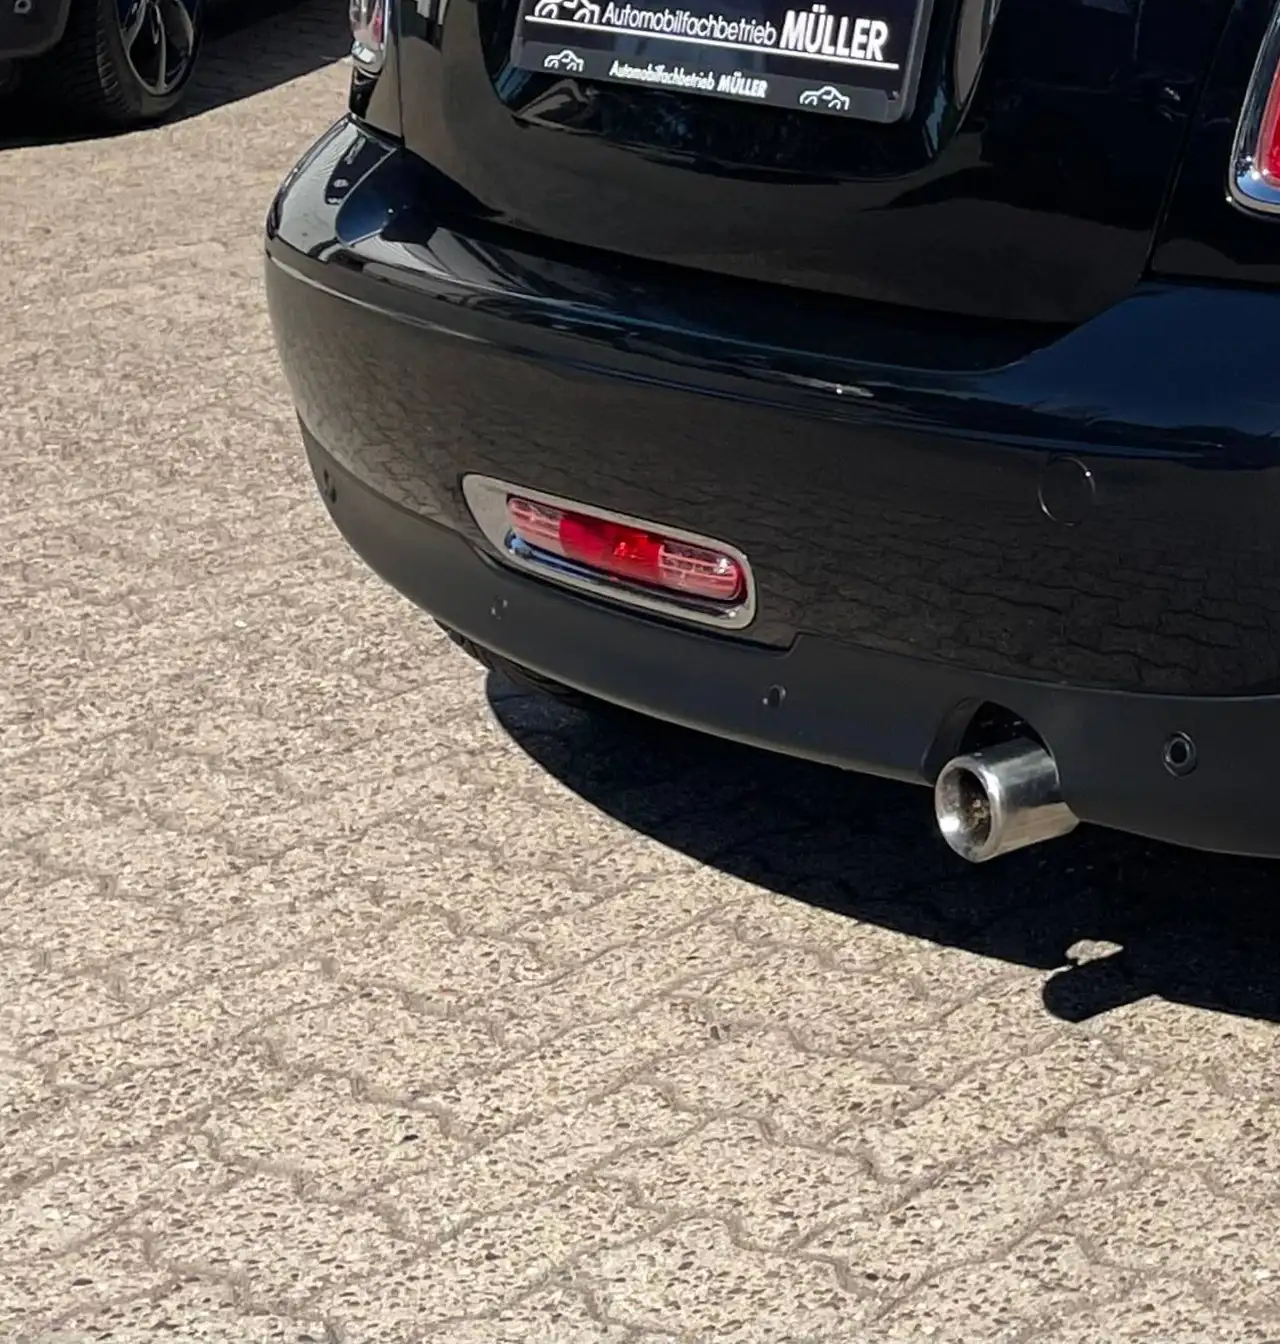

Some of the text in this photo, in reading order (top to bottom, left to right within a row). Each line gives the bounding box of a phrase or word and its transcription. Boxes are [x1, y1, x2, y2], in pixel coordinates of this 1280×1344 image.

[602, 1, 889, 61] Automobilfachbetrieb MÜLLER
[609, 60, 768, 98] Automobilfachbetrieb MÜLLER
